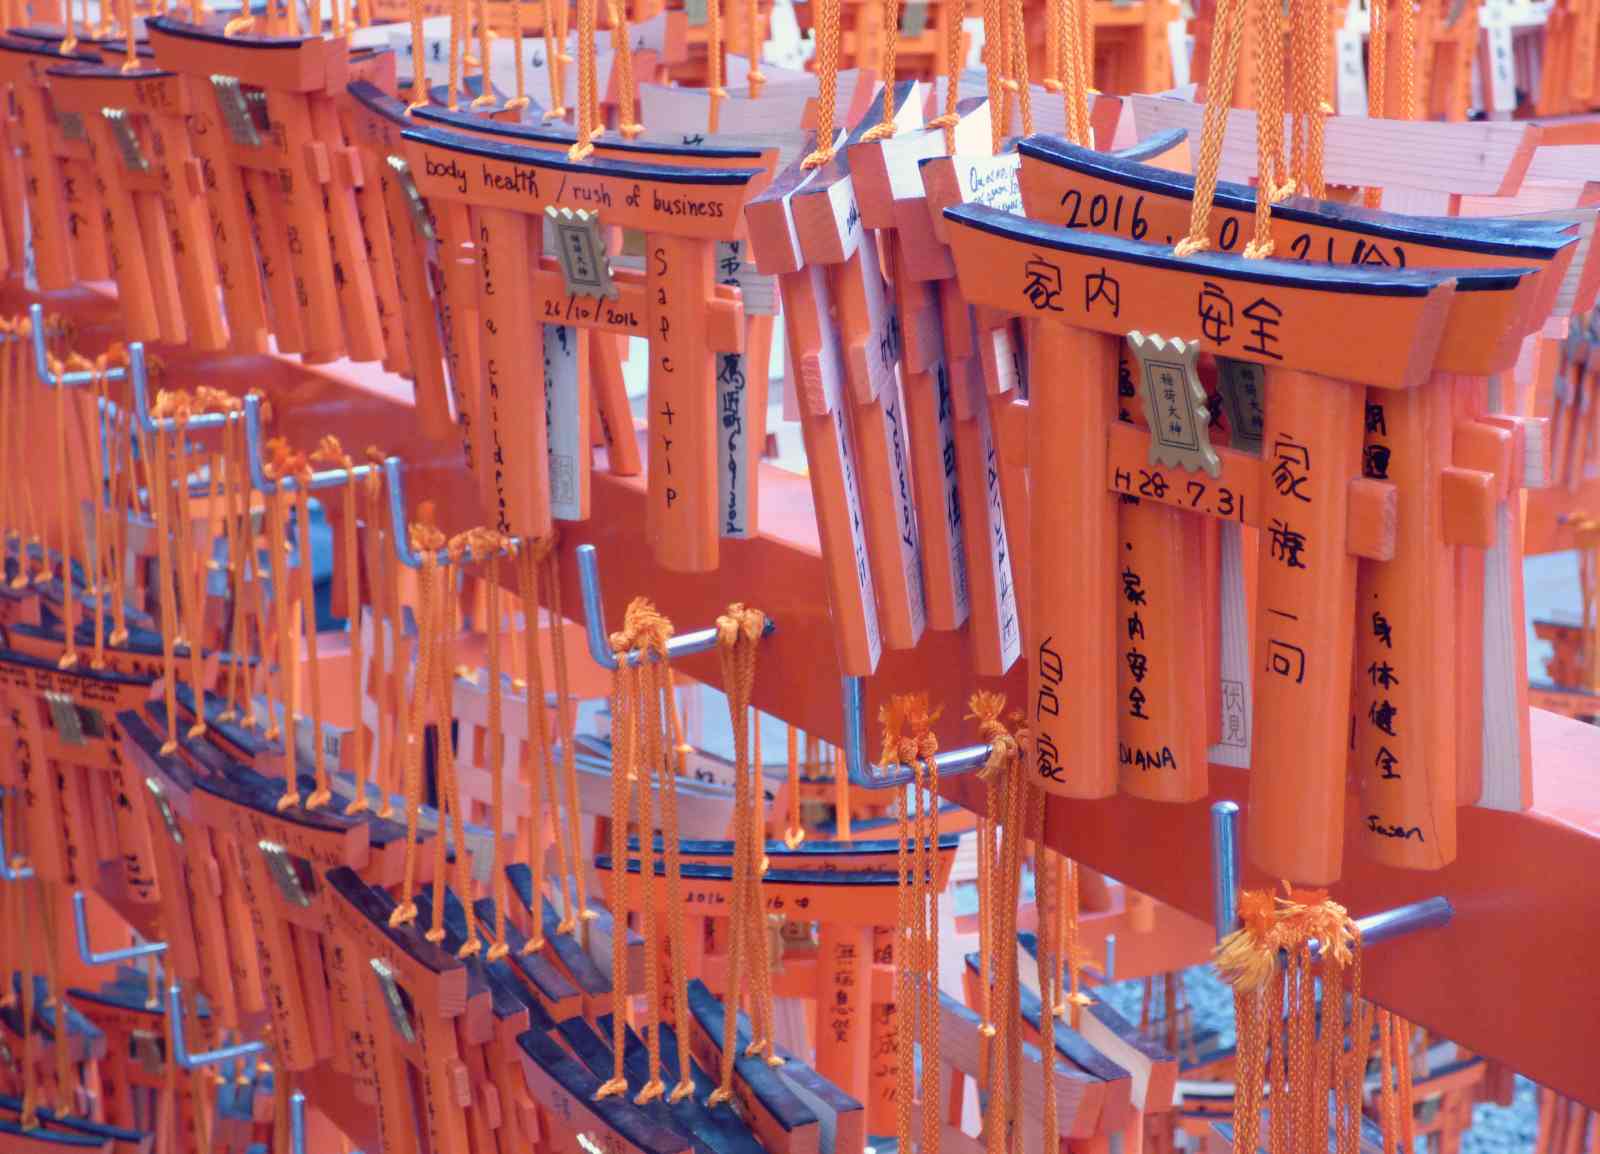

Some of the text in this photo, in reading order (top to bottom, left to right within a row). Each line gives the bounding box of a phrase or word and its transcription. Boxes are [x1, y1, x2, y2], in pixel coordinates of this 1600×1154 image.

[425, 154, 467, 192] body
[483, 165, 538, 195] health
[572, 186, 612, 207] rush
[625, 188, 641, 207] of
[653, 193, 724, 219] business
[1022, 253, 1284, 361] 家内安全
[1115, 467, 1245, 523] H28.7.31
[1118, 742, 1177, 770] DIANA
